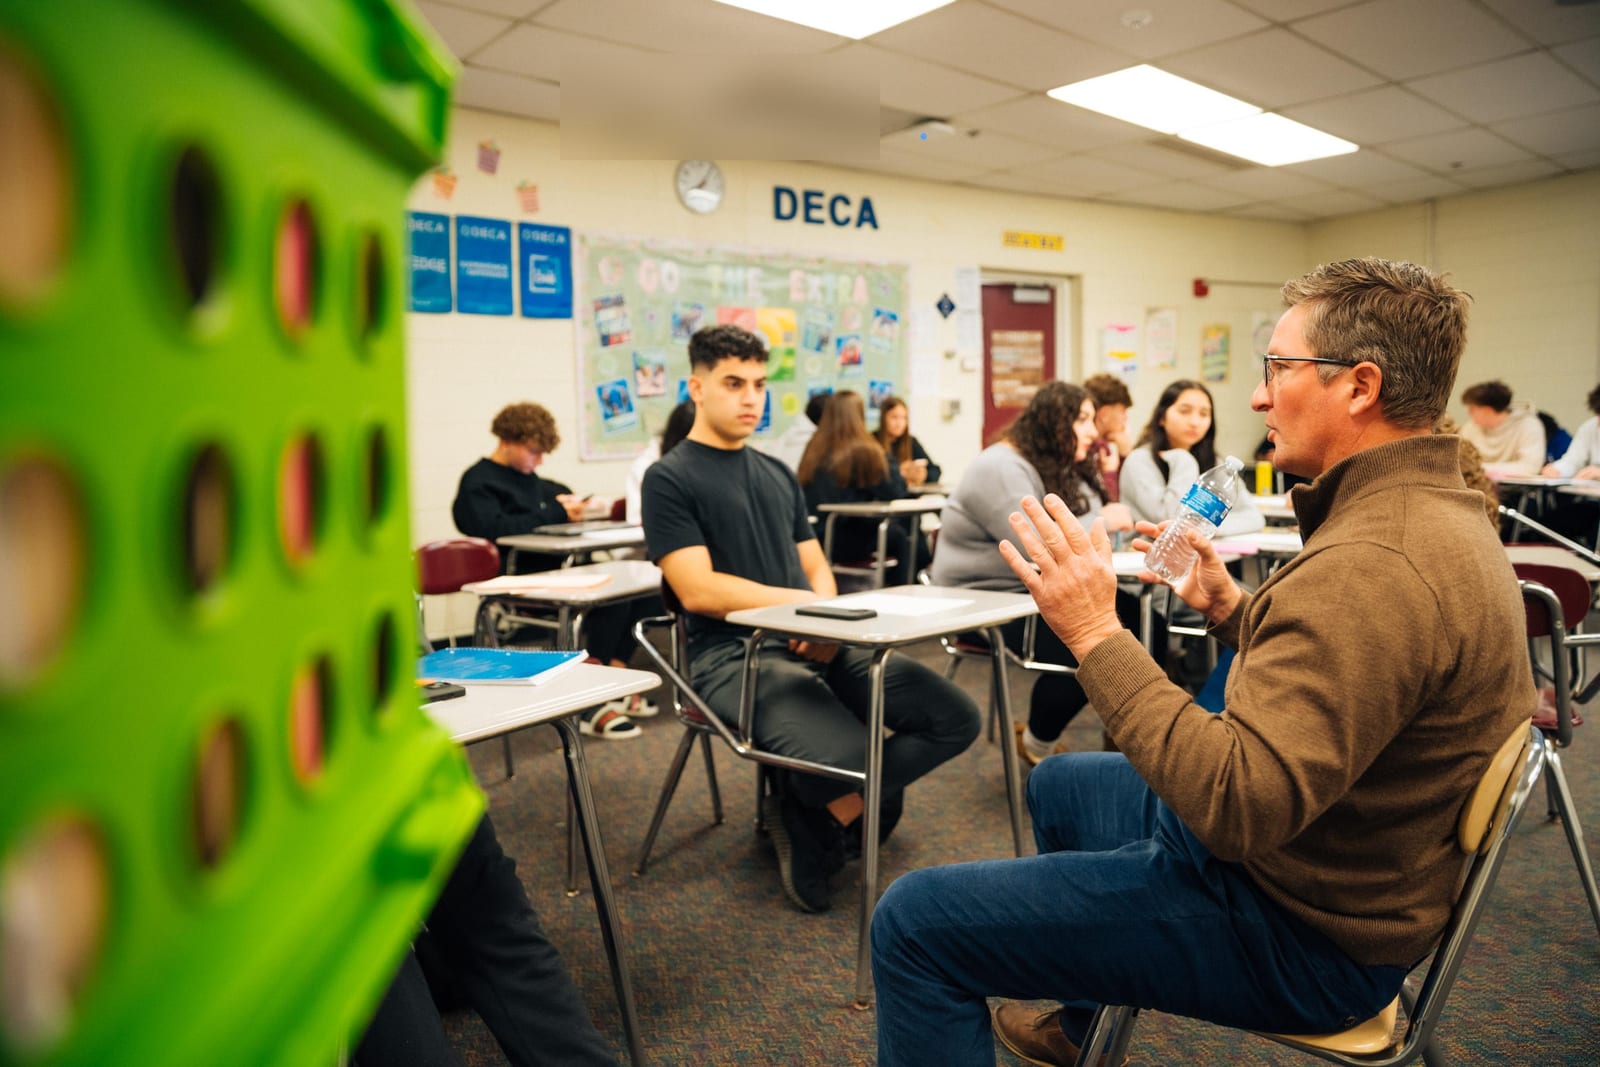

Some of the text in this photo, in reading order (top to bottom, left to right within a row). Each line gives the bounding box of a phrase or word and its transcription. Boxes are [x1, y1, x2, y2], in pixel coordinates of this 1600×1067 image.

[773, 185, 879, 230] DECA
[470, 225, 507, 241] DECA
[531, 229, 566, 244] DECA
[638, 258, 868, 304] GO THE EXTRA
